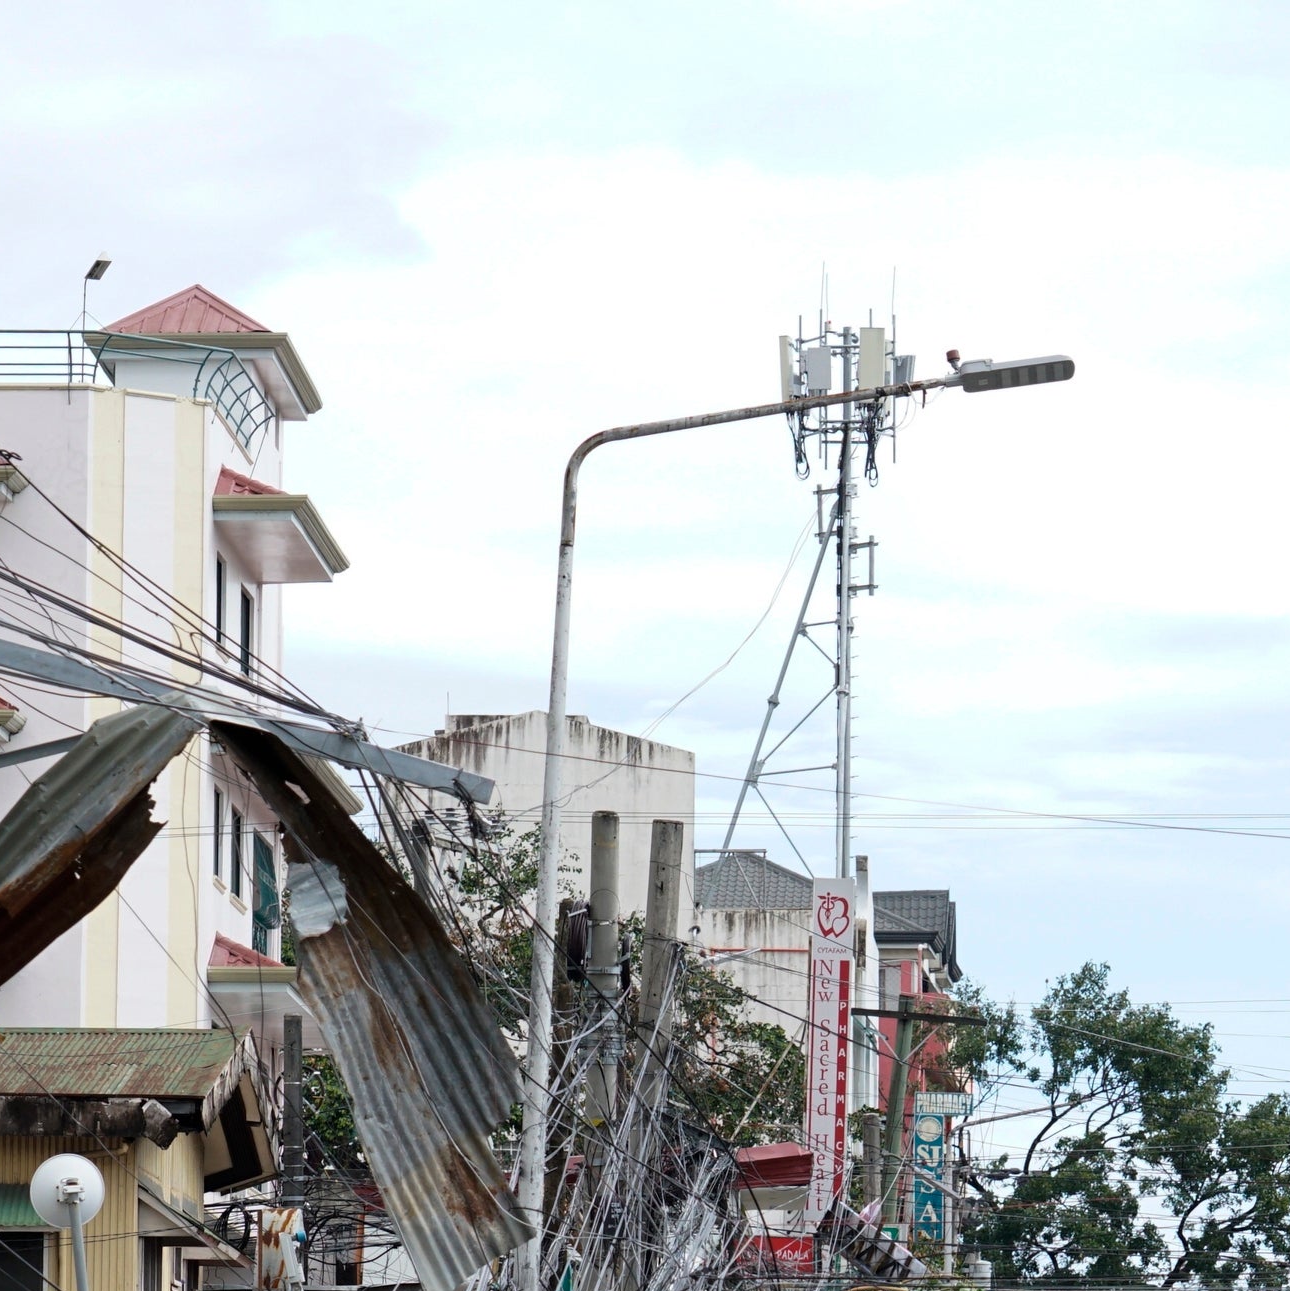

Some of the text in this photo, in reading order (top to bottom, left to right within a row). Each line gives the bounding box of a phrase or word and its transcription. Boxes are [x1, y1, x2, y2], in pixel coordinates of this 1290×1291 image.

[818, 959, 835, 1002] New
[816, 1018, 831, 1116] Sacred
[835, 1001, 848, 1172] PHARMACY
[916, 1093, 973, 1115] PHARMACY
[777, 1249, 810, 1261] PADALA
